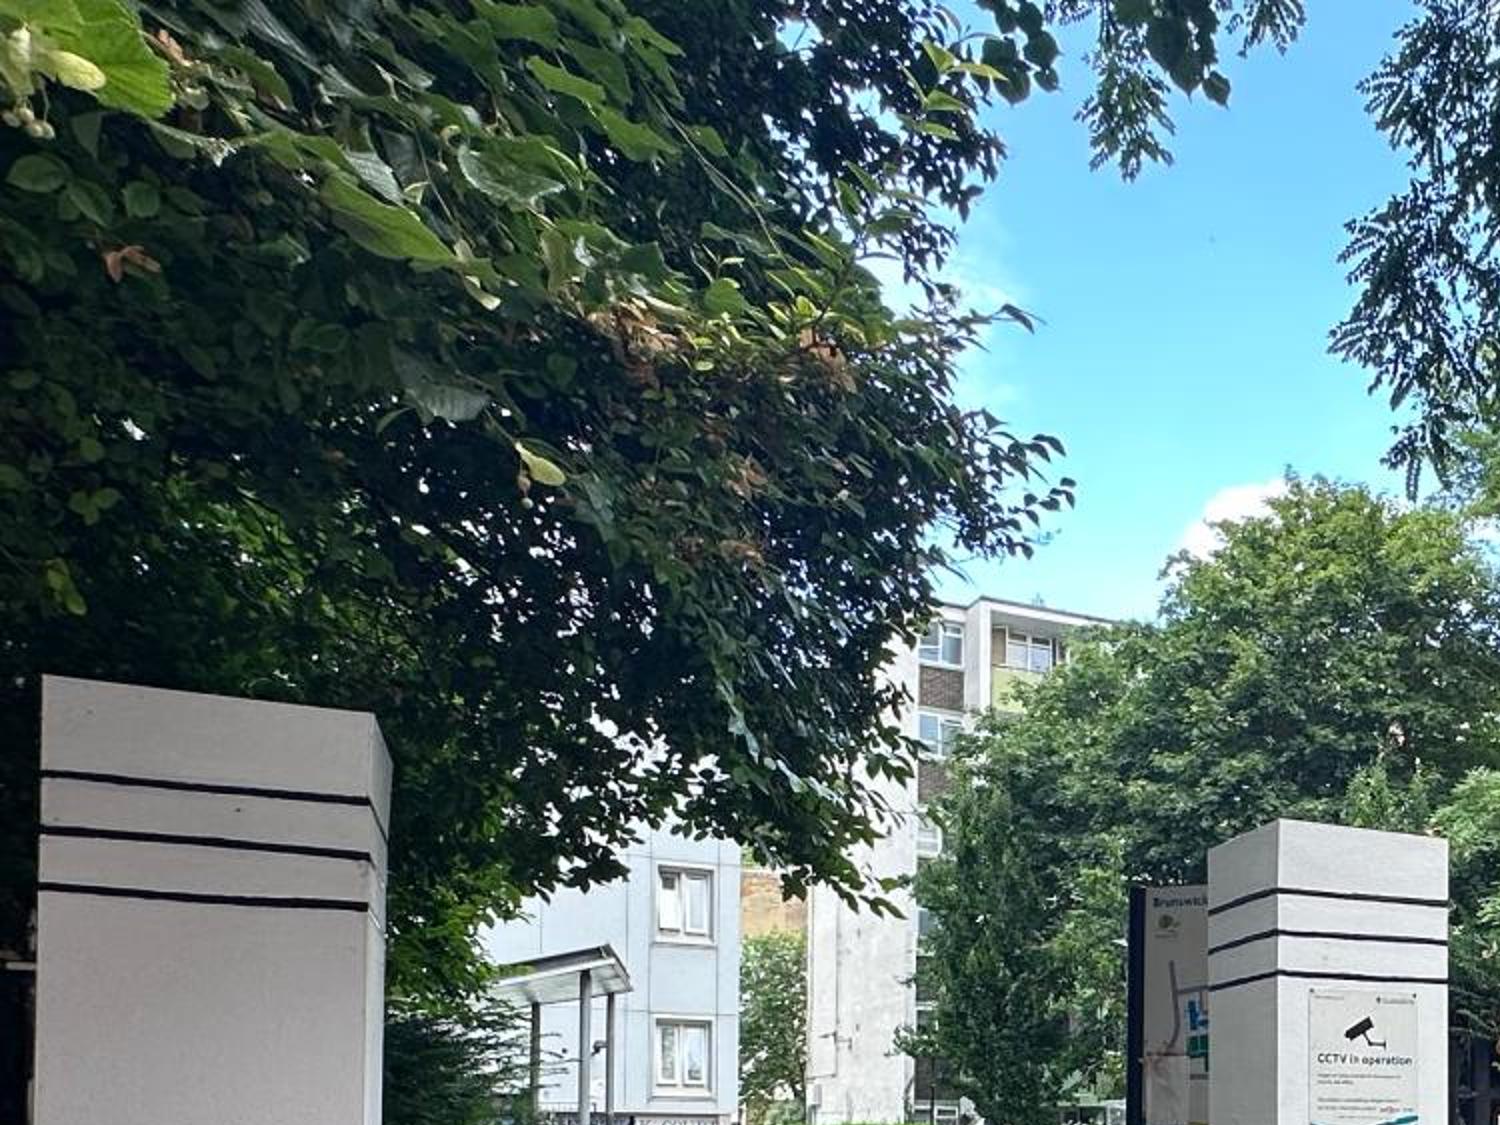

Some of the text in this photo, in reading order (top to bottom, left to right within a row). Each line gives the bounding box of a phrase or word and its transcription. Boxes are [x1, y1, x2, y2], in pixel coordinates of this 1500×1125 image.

[1317, 1053, 1413, 1067] CCTV in operation
